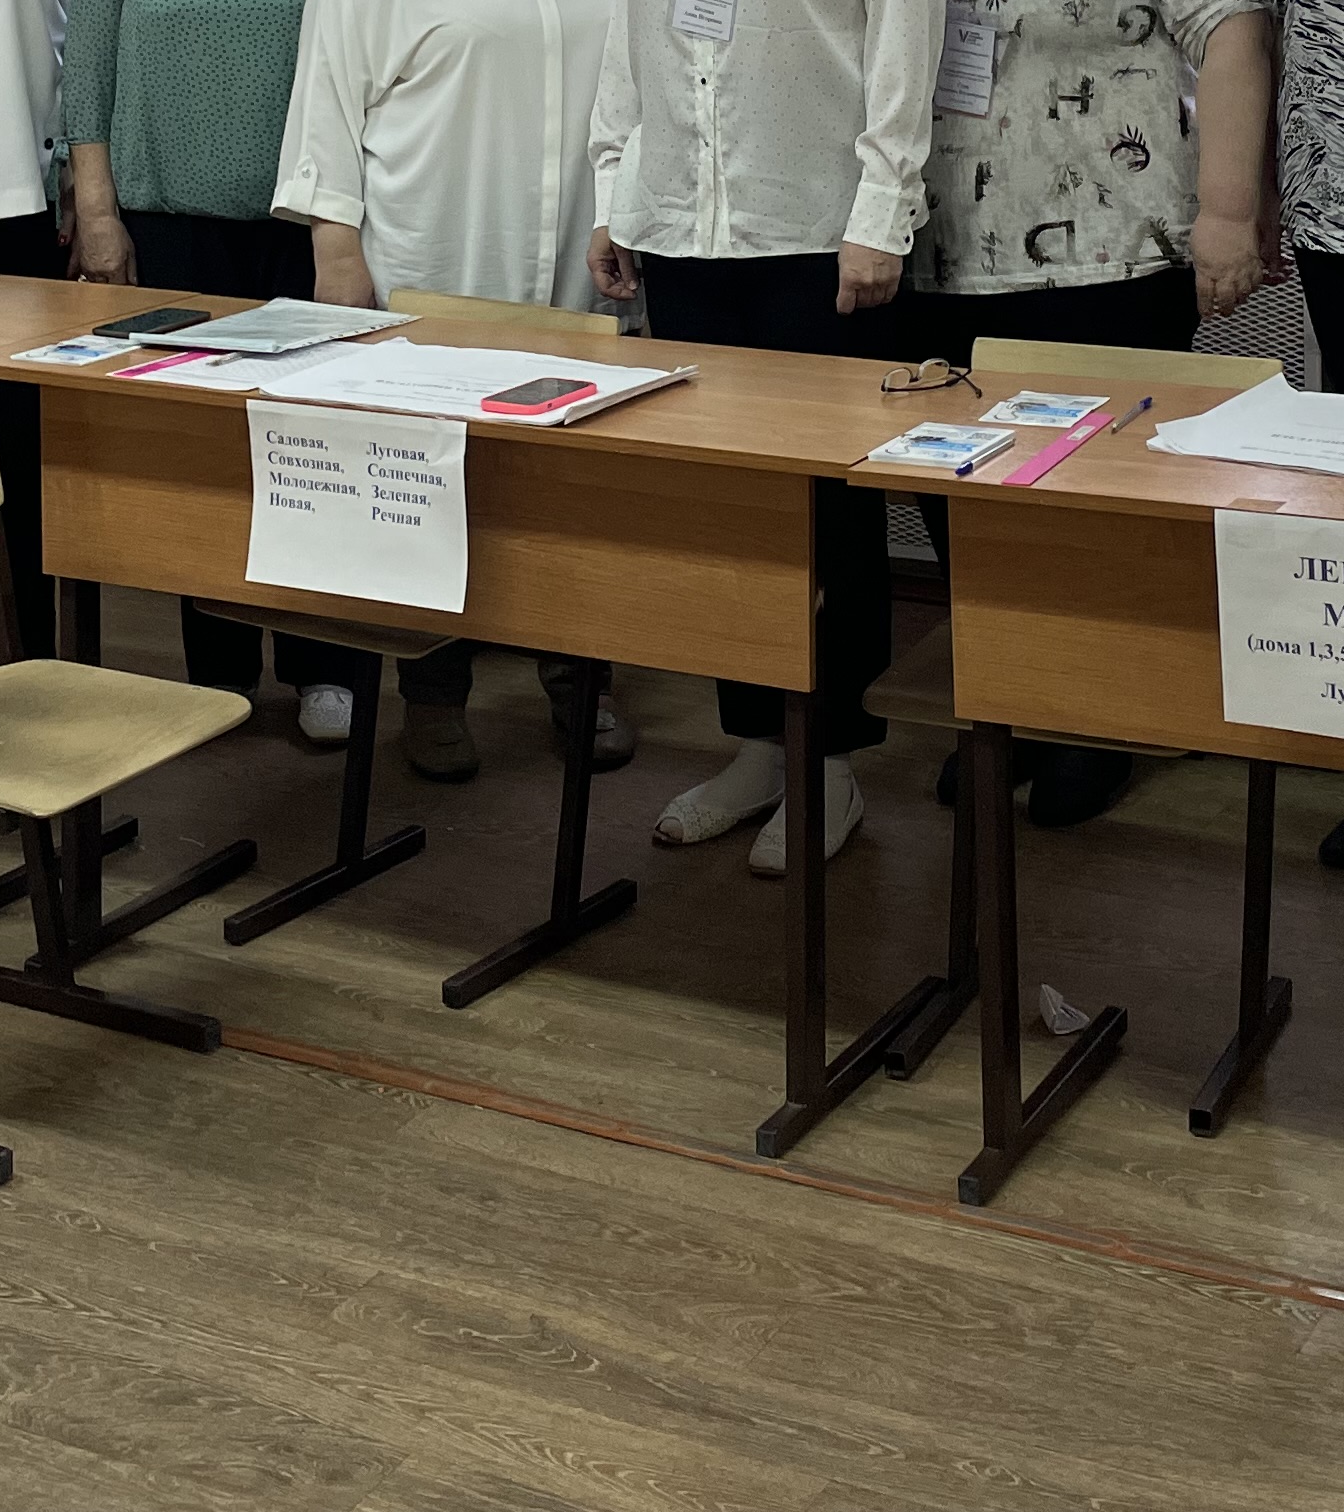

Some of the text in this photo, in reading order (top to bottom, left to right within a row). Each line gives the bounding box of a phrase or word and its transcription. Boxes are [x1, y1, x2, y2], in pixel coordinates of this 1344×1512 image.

[266, 430, 329, 452] Садовая,
[267, 450, 345, 473] Совхозная,
[366, 441, 429, 464] Луговая,
[269, 472, 361, 497] Молодежная,
[367, 463, 447, 489] Солнечная,
[269, 493, 316, 513] Новая,
[371, 485, 431, 507] Зеленая,
[371, 506, 421, 527] Речная
[1247, 634, 1301, 656] (дома
